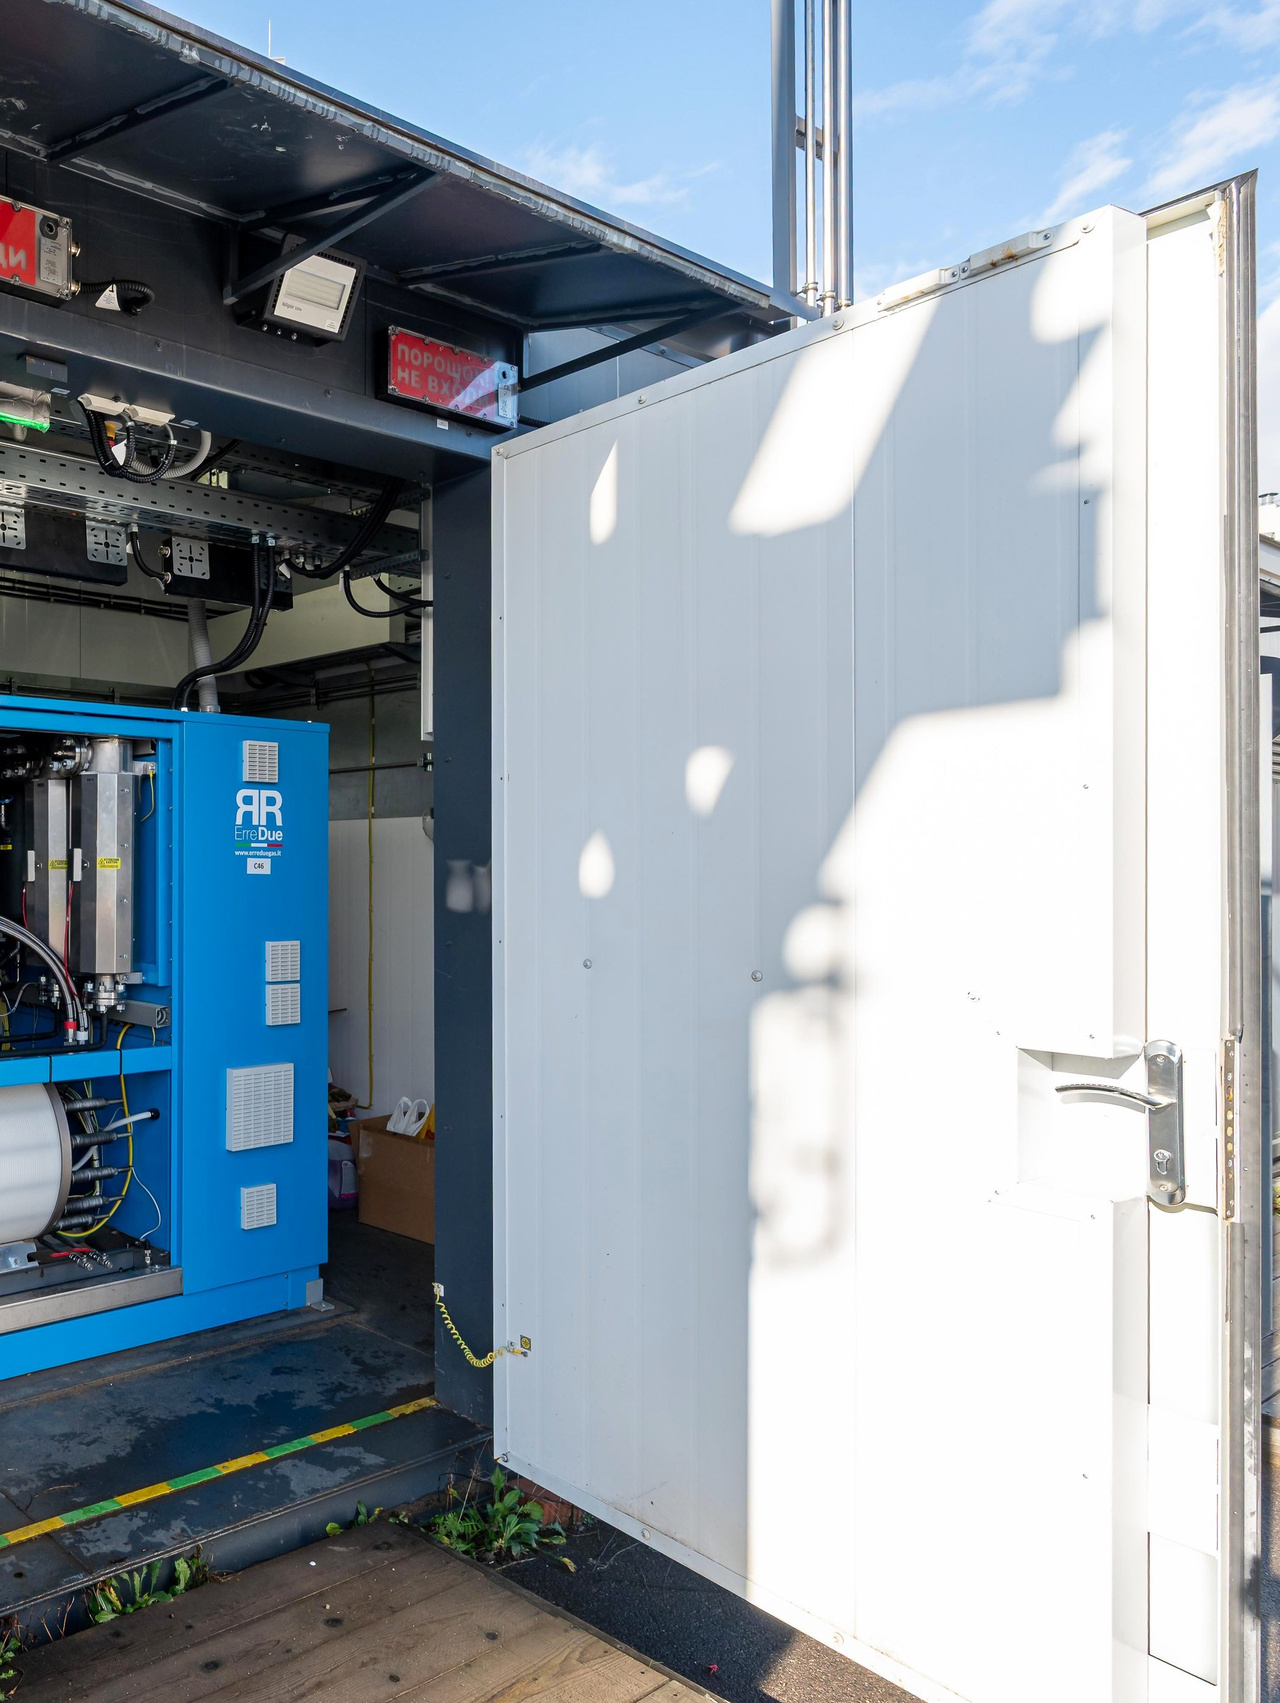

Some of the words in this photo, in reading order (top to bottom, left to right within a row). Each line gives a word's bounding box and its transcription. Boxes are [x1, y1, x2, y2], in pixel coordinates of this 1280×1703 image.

[397, 365, 422, 389] НЕ
[234, 826, 283, 841] ErreDue
[253, 862, 265, 870] C46
